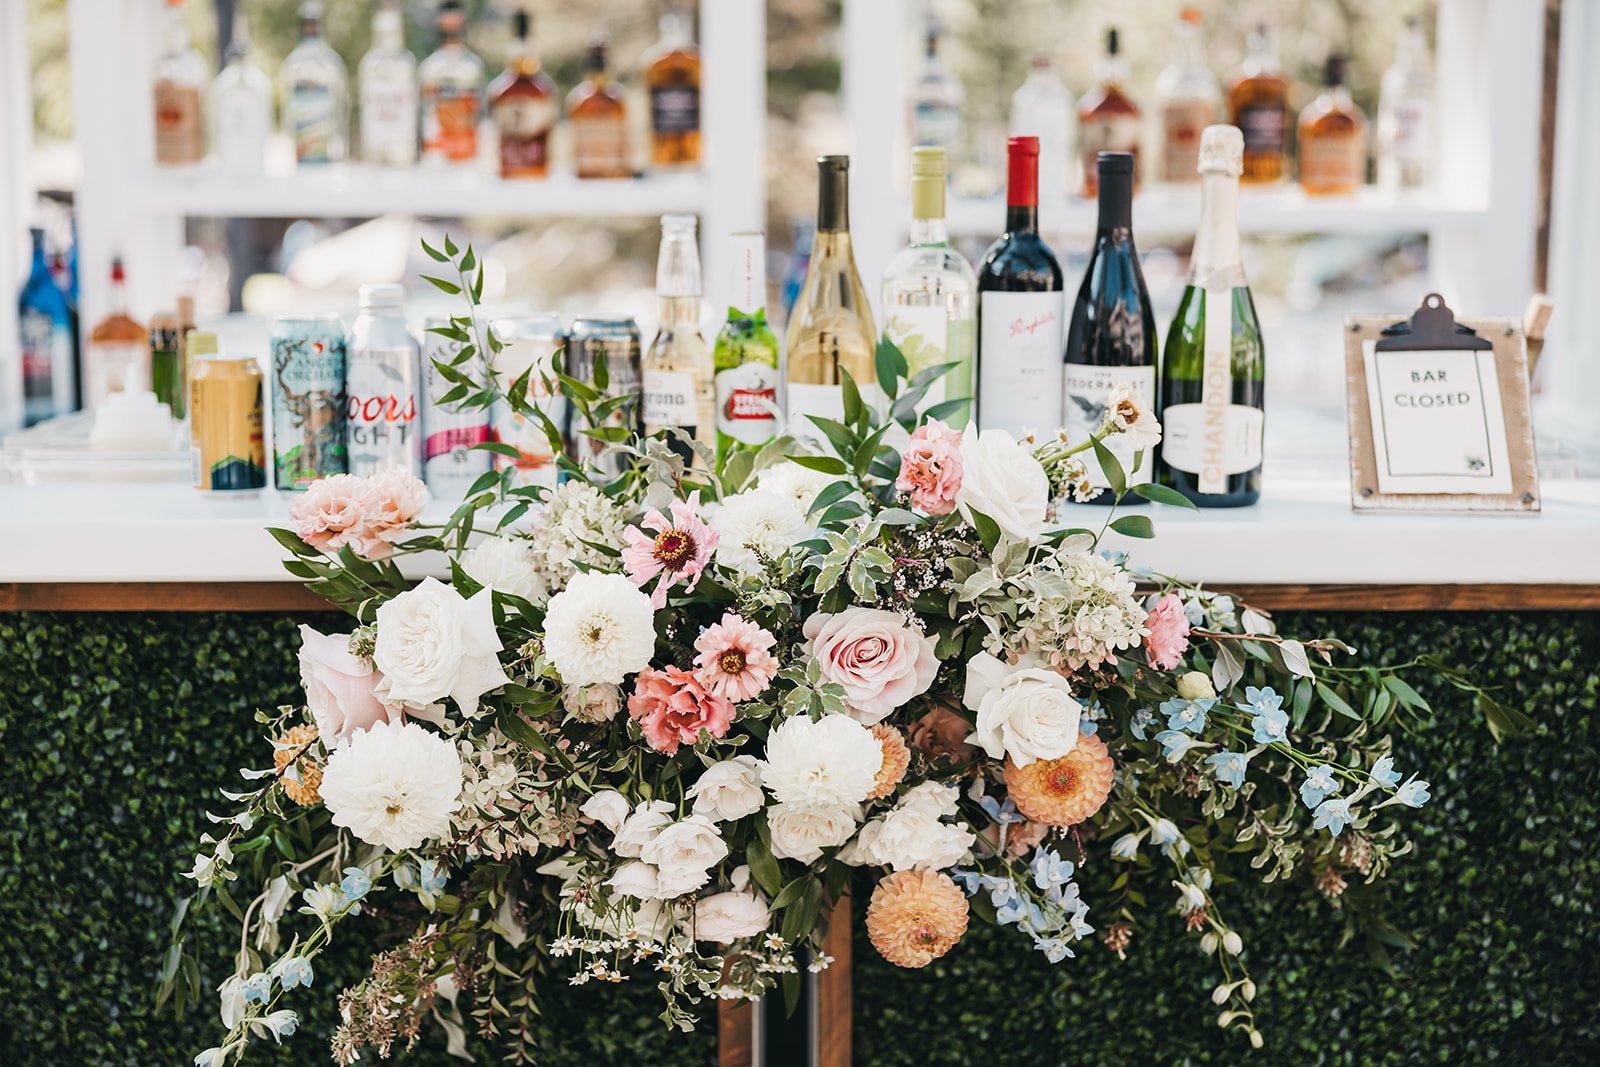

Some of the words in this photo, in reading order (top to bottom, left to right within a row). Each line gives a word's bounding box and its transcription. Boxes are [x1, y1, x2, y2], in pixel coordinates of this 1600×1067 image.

[1411, 370, 1448, 383] BAR
[348, 394, 416, 422] oors
[1394, 393, 1470, 408] CLOSED
[1203, 351, 1226, 484] CHANDON
